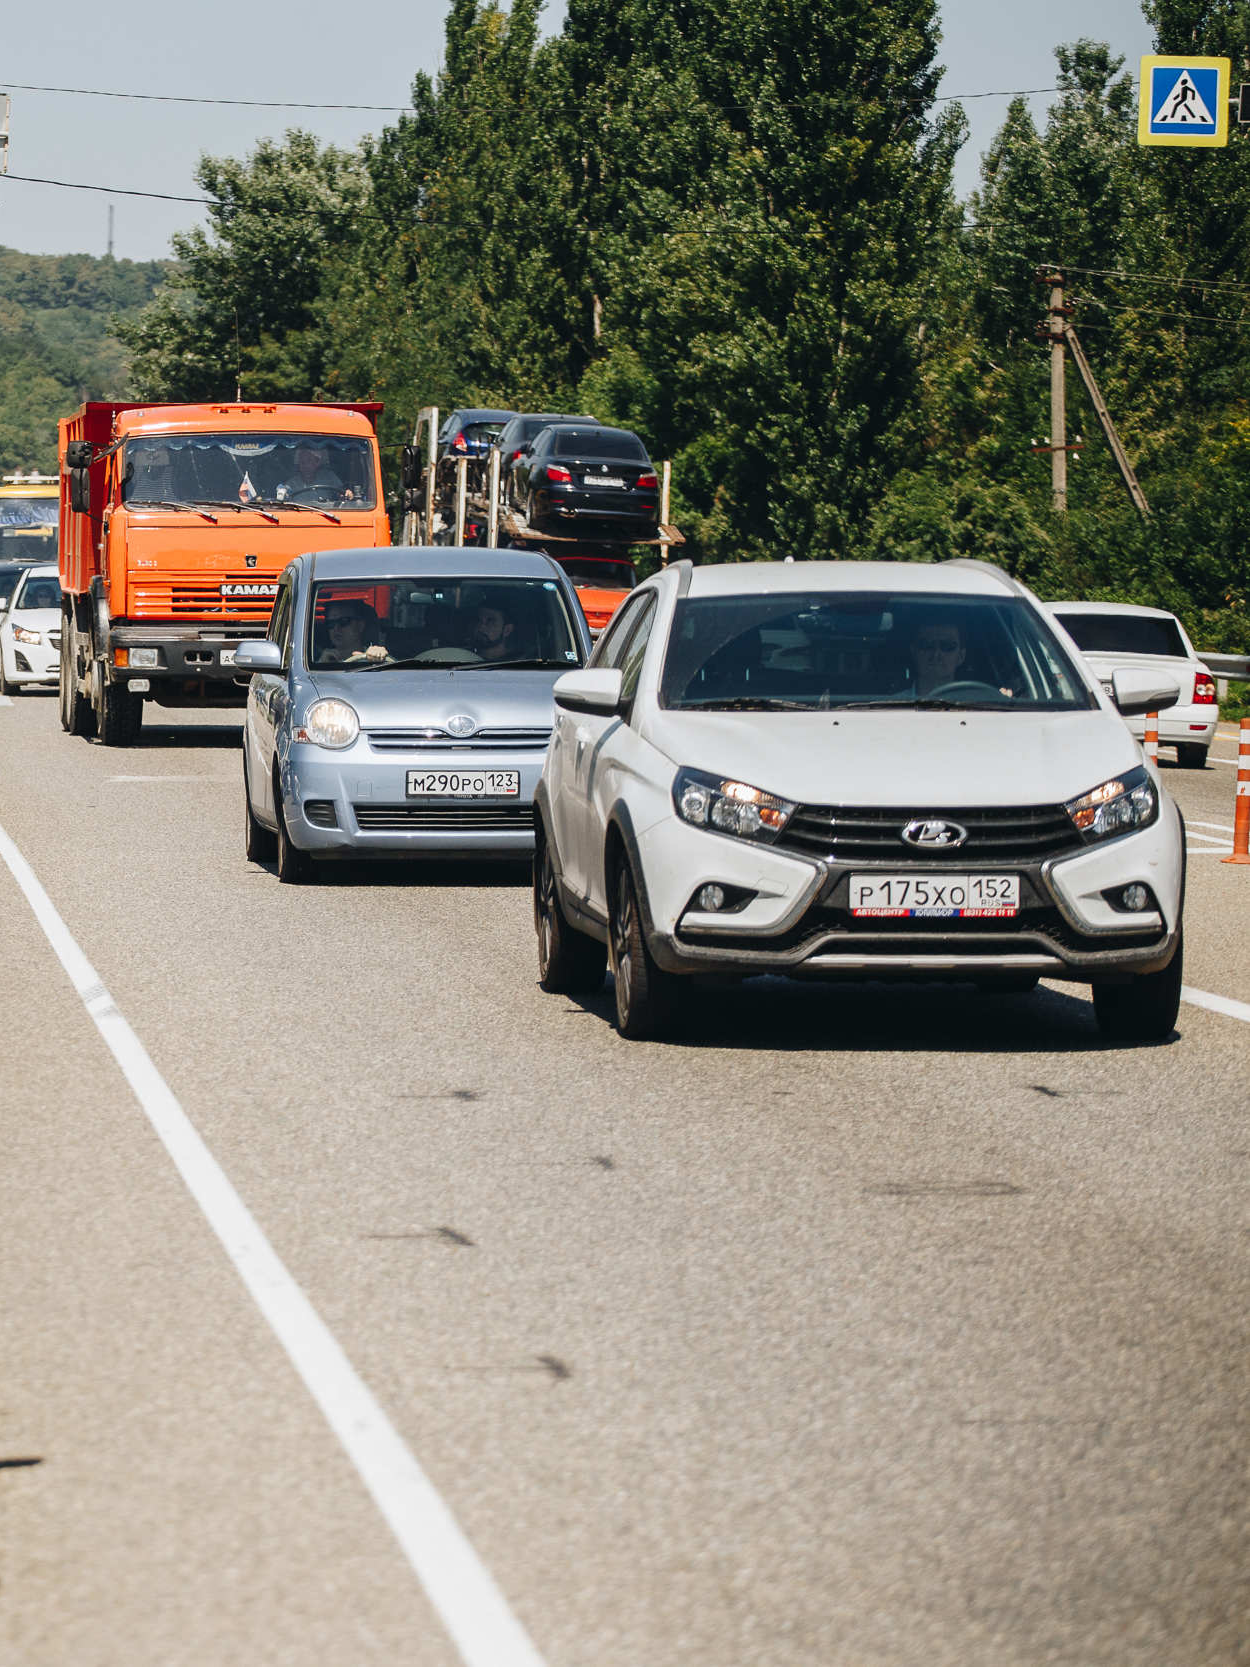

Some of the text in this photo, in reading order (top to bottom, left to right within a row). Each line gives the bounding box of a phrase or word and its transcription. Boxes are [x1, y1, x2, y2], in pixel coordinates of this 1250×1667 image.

[221, 584, 279, 595] KAMAZ
[413, 773, 513, 792] М290РО 123
[859, 878, 1012, 906] Р175ХО 152
[980, 899, 1001, 907] RUS
[855, 908, 905, 917] АВТОЦЕНТР
[982, 908, 997, 917] 422
